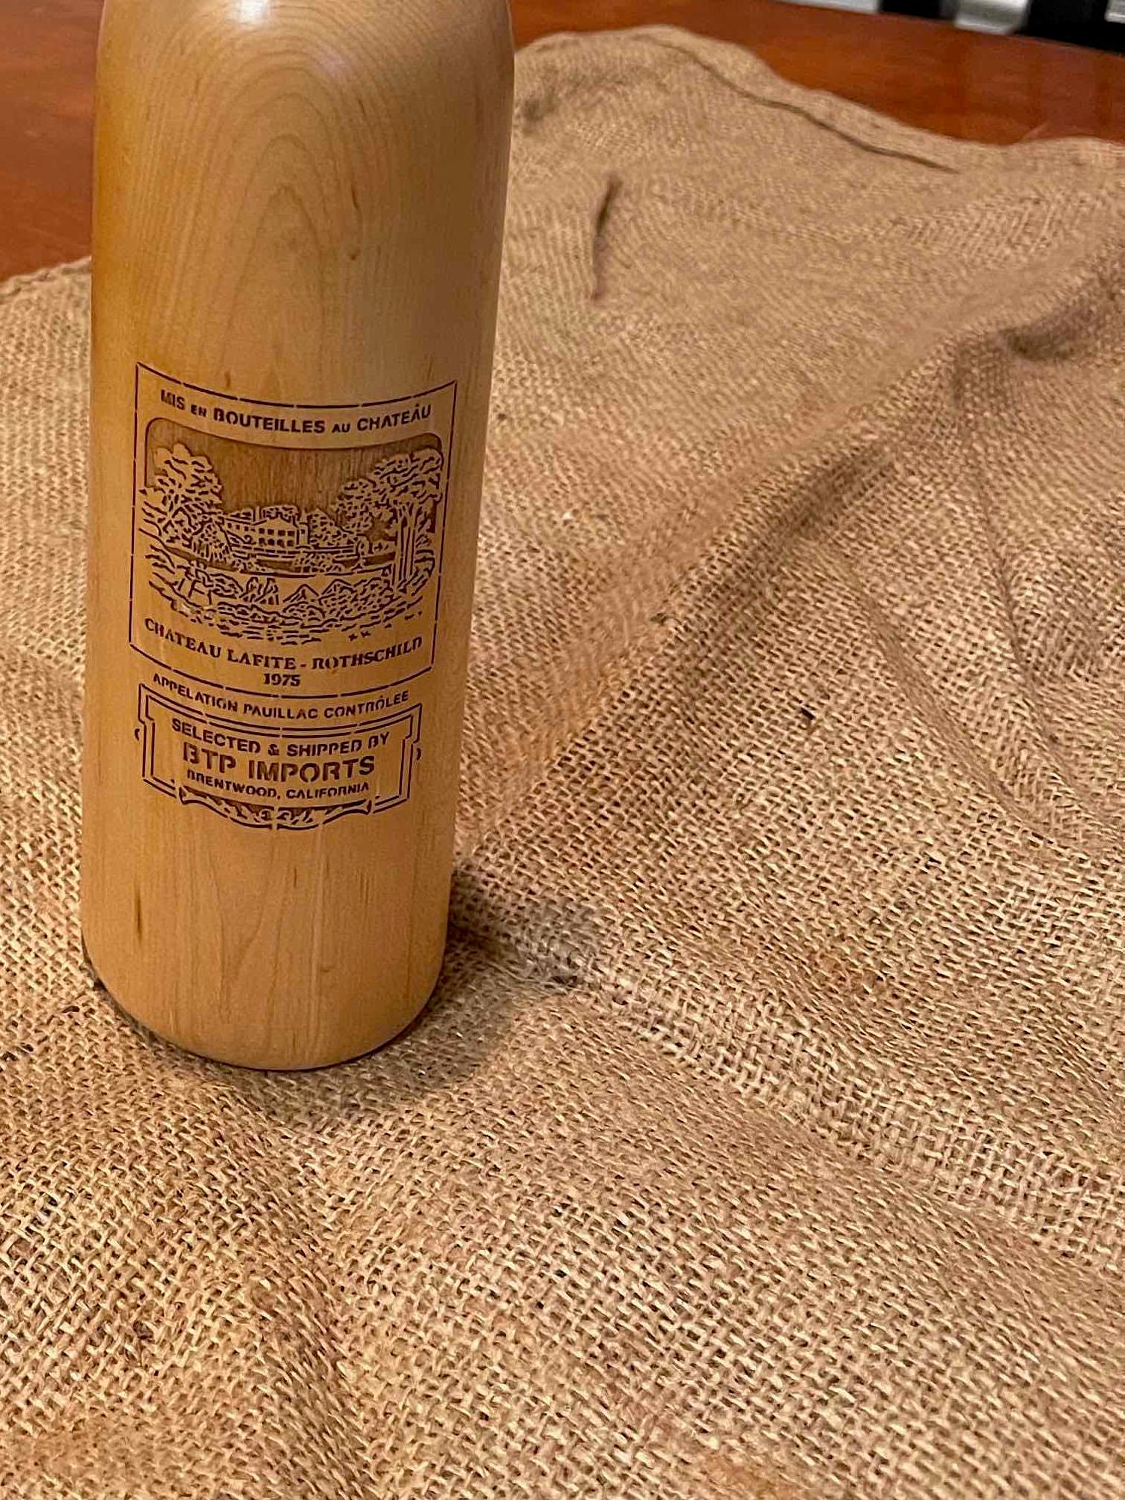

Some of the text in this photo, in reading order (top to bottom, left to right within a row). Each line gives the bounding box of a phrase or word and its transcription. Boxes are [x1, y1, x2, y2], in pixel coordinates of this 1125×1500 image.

[160, 389, 185, 411] MIS
[213, 407, 325, 434] BOUTEILLES
[331, 421, 350, 433] AU
[144, 617, 222, 659] CHATEAU
[226, 649, 296, 670] LAFITE
[311, 636, 422, 670] ROTHSCHILD
[152, 673, 237, 713] APPELATION
[243, 703, 318, 719] PAUILLAC
[262, 673, 301, 687] 1975
[171, 717, 389, 757] SELECTED & SHIPPED BY
[183, 741, 375, 783] BTP IMPORTS
[186, 768, 369, 800] BRENTWOOD, CALIFORNIA
